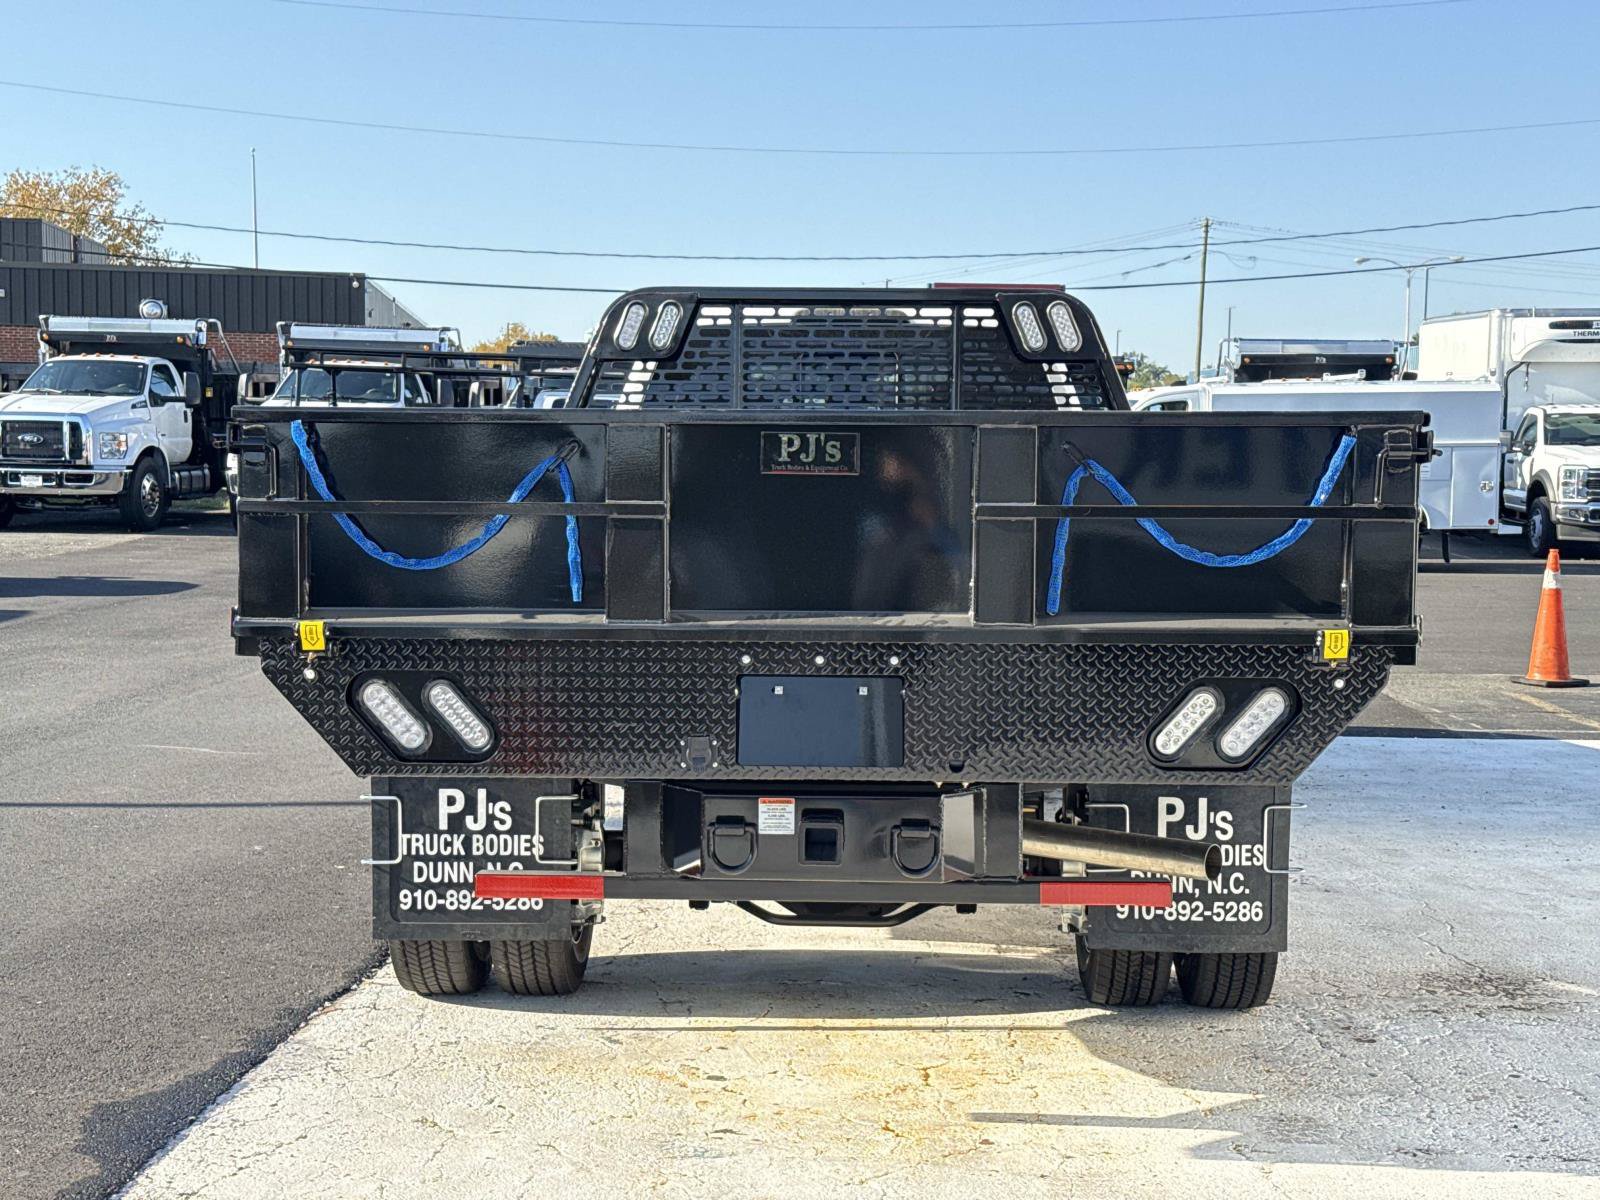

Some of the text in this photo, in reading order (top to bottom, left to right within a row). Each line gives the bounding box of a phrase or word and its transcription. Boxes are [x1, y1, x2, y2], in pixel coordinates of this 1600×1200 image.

[777, 432, 842, 463] PJ's
[401, 833, 544, 856] TRUCK BODIES
[1221, 844, 1264, 867] DIES
[1208, 871, 1250, 895] N.C.
[1115, 901, 1264, 922] 910-892-5286
